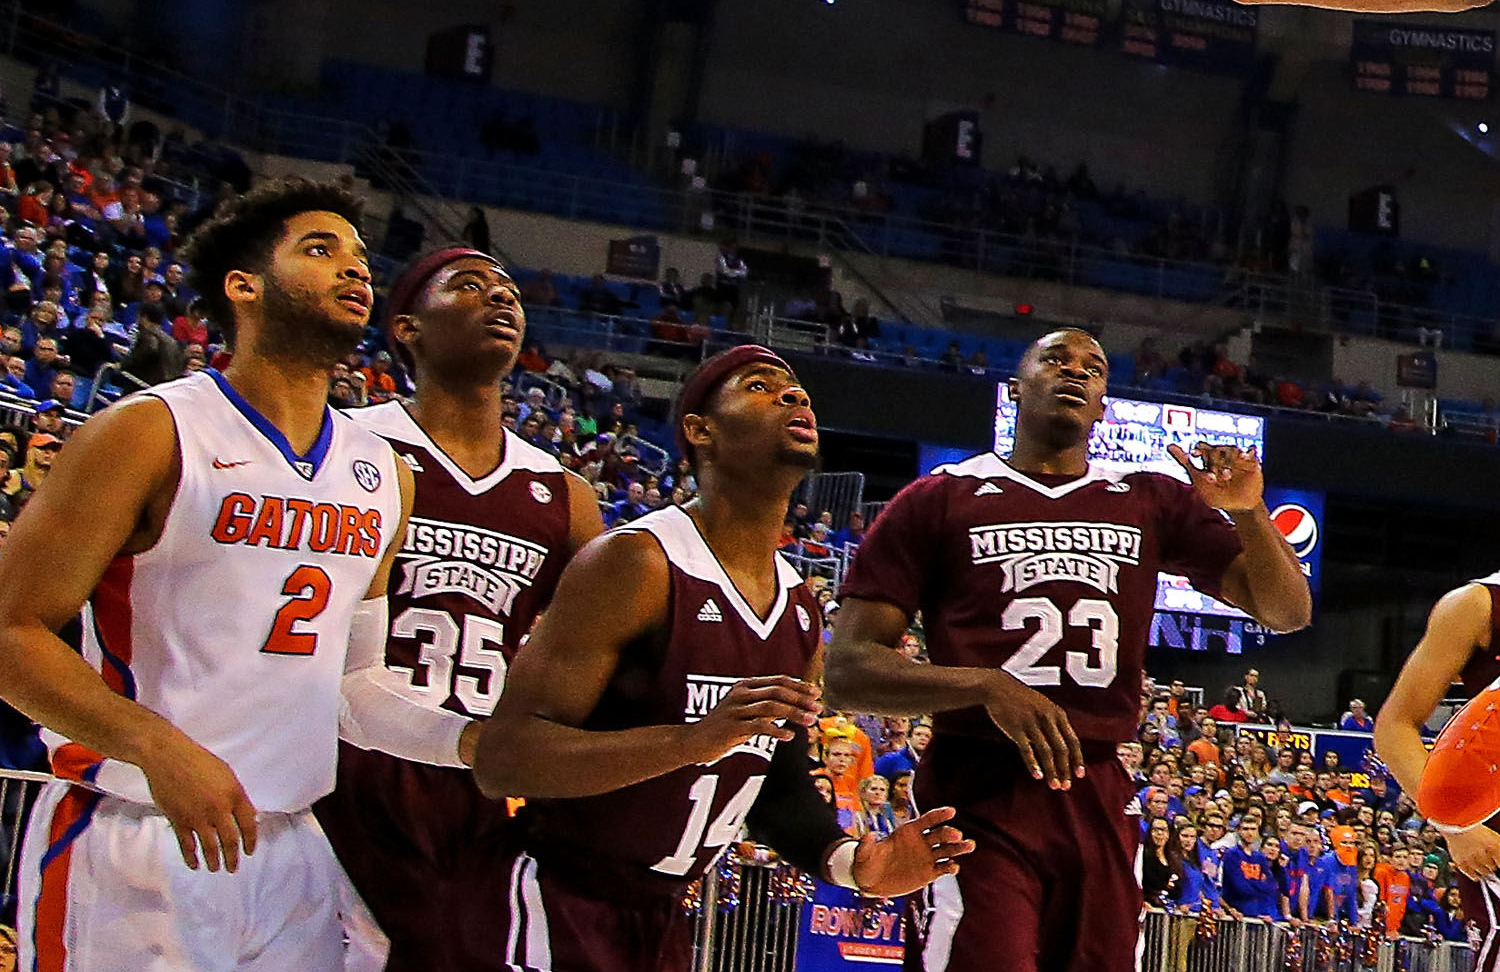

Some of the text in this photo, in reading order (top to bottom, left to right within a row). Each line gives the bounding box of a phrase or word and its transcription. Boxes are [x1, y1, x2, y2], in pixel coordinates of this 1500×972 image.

[1389, 28, 1494, 53] GYMNASTICS
[211, 491, 383, 559] GATORS
[969, 527, 1142, 560] MISSISSIPPI
[424, 566, 503, 602] STATE
[1022, 557, 1103, 581] STATE
[260, 564, 333, 656] 2
[391, 607, 508, 717] 35
[1001, 597, 1120, 689] 23
[1256, 634, 1266, 646] 3
[650, 774, 767, 876] 14
